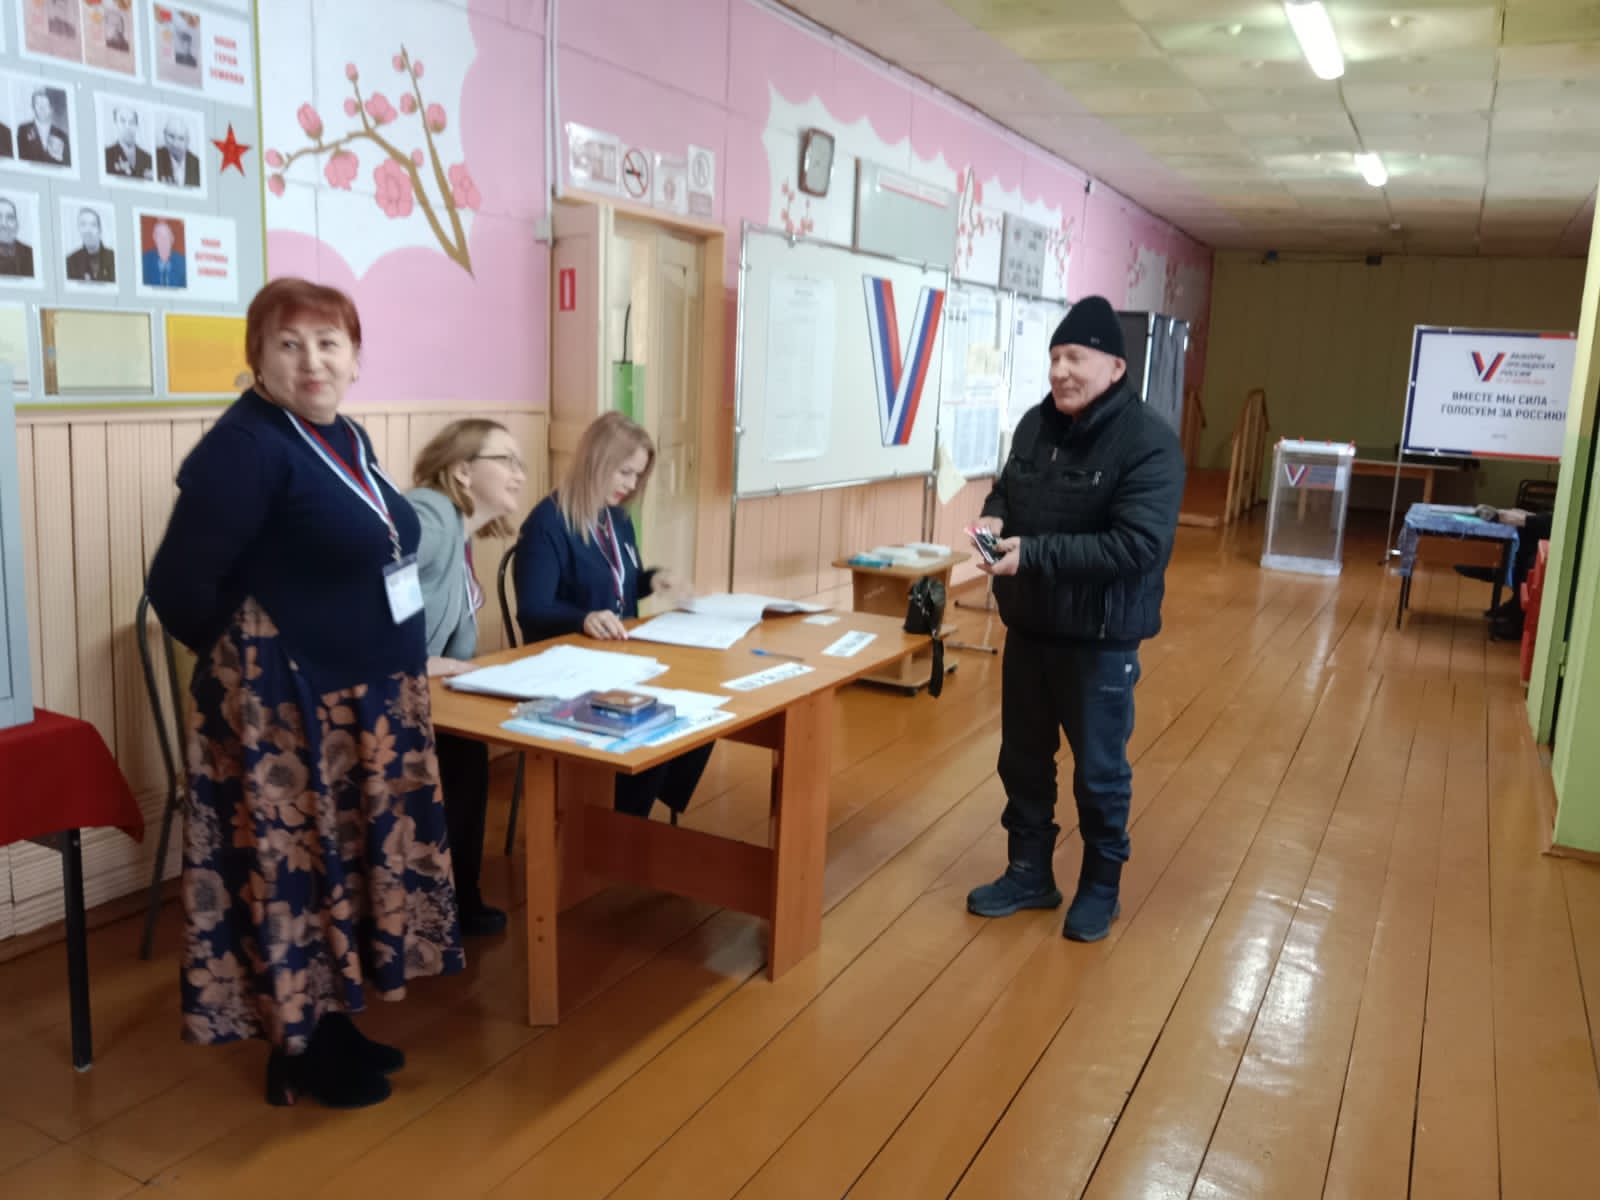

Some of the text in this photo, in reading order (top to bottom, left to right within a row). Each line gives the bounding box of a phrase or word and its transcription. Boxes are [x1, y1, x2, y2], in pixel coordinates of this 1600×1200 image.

[1451, 391, 1493, 403] ВМЕСТЕ
[1496, 392, 1516, 405] МЫ
[1518, 393, 1548, 406] СИЛА
[1440, 403, 1497, 417] ГОЛОСУЕМ
[1500, 407, 1513, 418] ЗА
